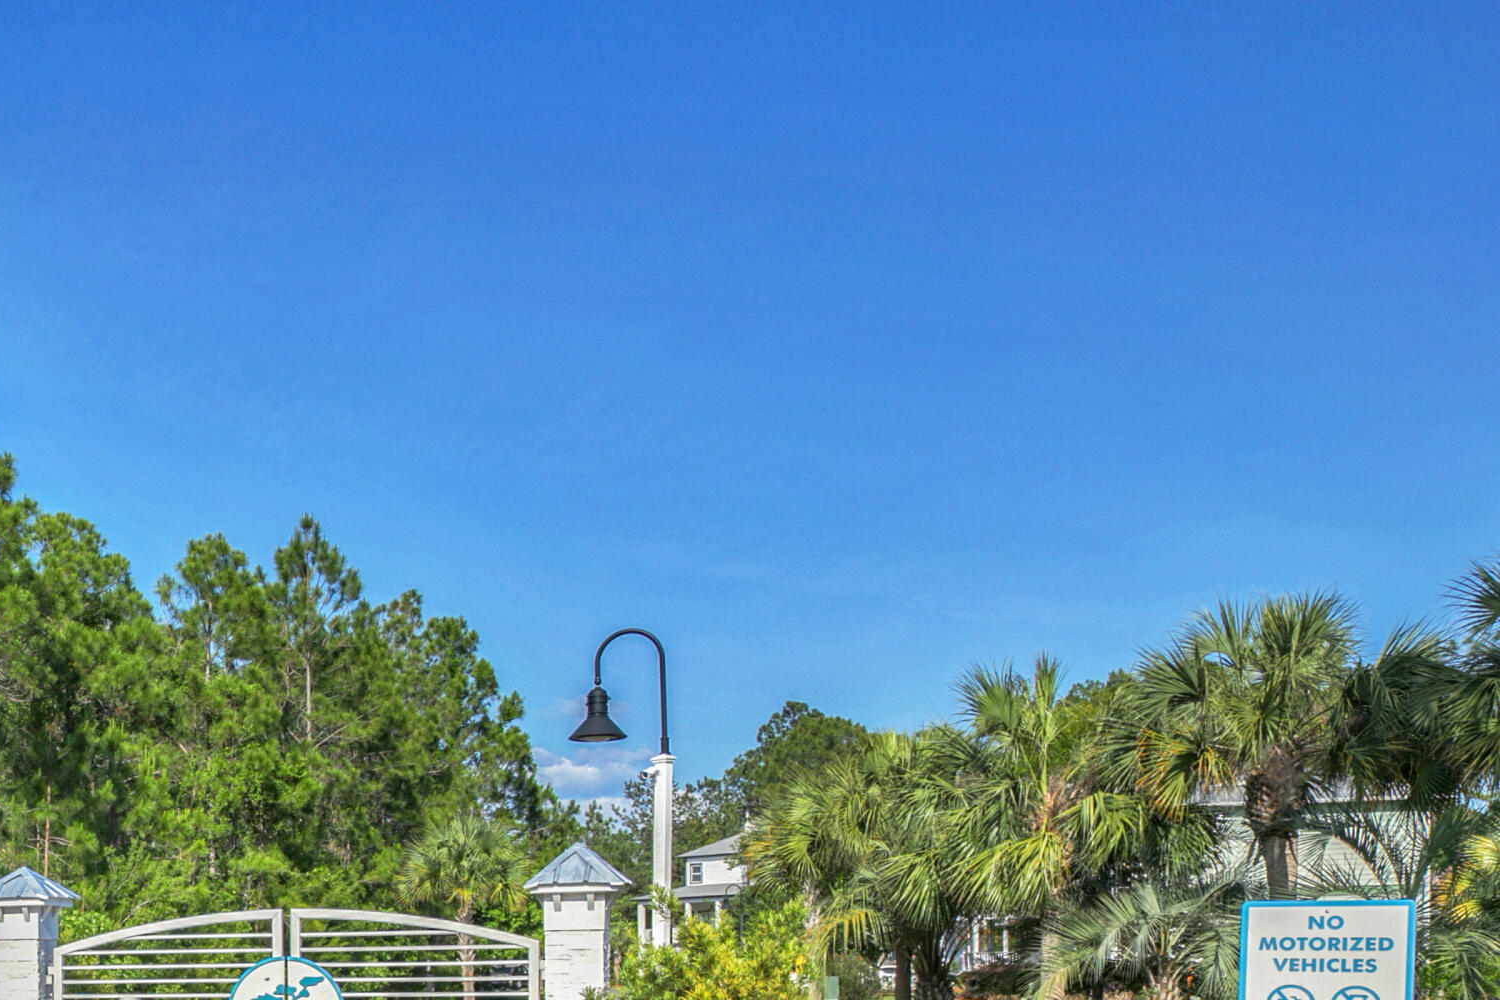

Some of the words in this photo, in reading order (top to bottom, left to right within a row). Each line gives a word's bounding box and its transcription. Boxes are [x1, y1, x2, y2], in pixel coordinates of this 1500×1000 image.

[1308, 916, 1344, 930] NO
[1259, 937, 1394, 951] MOTORIZED
[1273, 958, 1377, 973] VEHICLES
